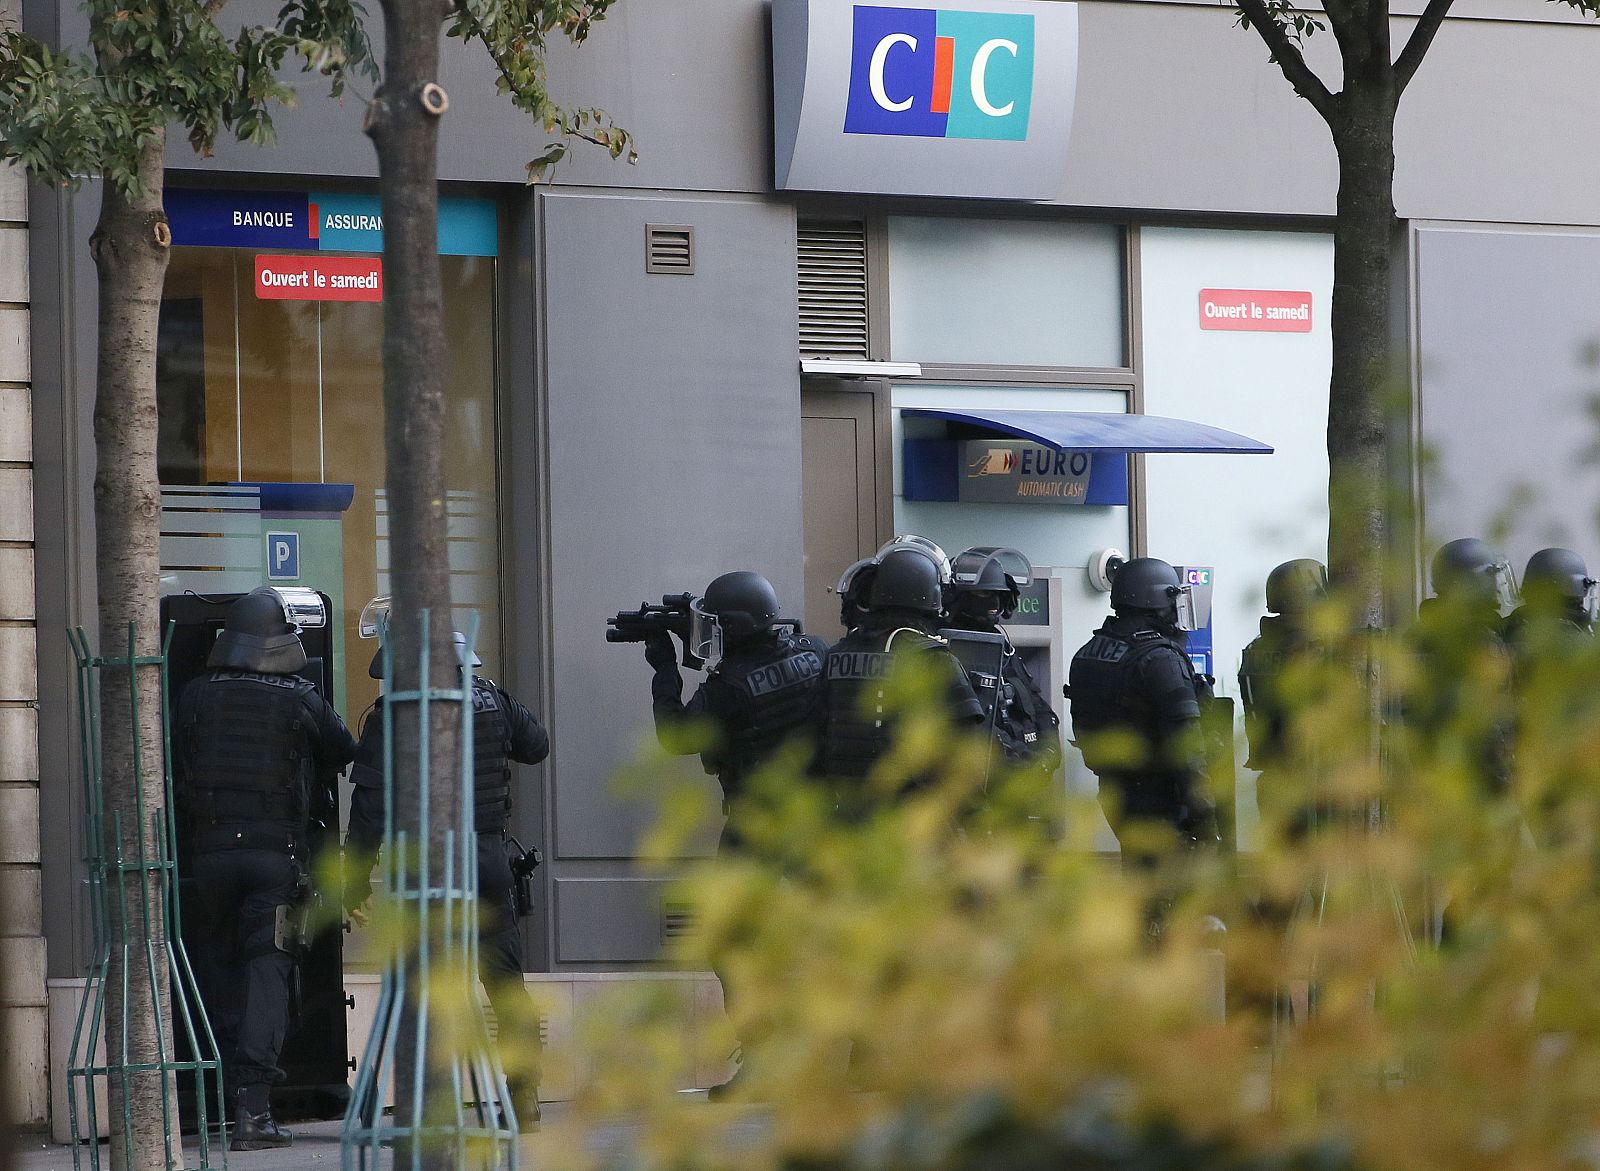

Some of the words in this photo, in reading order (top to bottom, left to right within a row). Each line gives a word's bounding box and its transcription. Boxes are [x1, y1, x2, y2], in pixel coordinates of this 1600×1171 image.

[868, 33, 1018, 117] CIC
[232, 210, 294, 229] BANQUE
[325, 213, 385, 232] ASSURAN
[261, 269, 309, 288] Ouvert
[313, 269, 326, 288] le
[330, 271, 378, 289] samedi
[1204, 301, 1248, 319] Ouvert
[1250, 301, 1263, 319] le
[1266, 303, 1309, 320] samedi
[1020, 448, 1088, 476] EURO
[1017, 481, 1061, 497] AUTOMATIC
[1063, 481, 1085, 497] CASH
[275, 540, 290, 570] P
[1188, 570, 1209, 584] CIC
[1016, 597, 1040, 613] ice
[753, 652, 822, 694] POLICE
